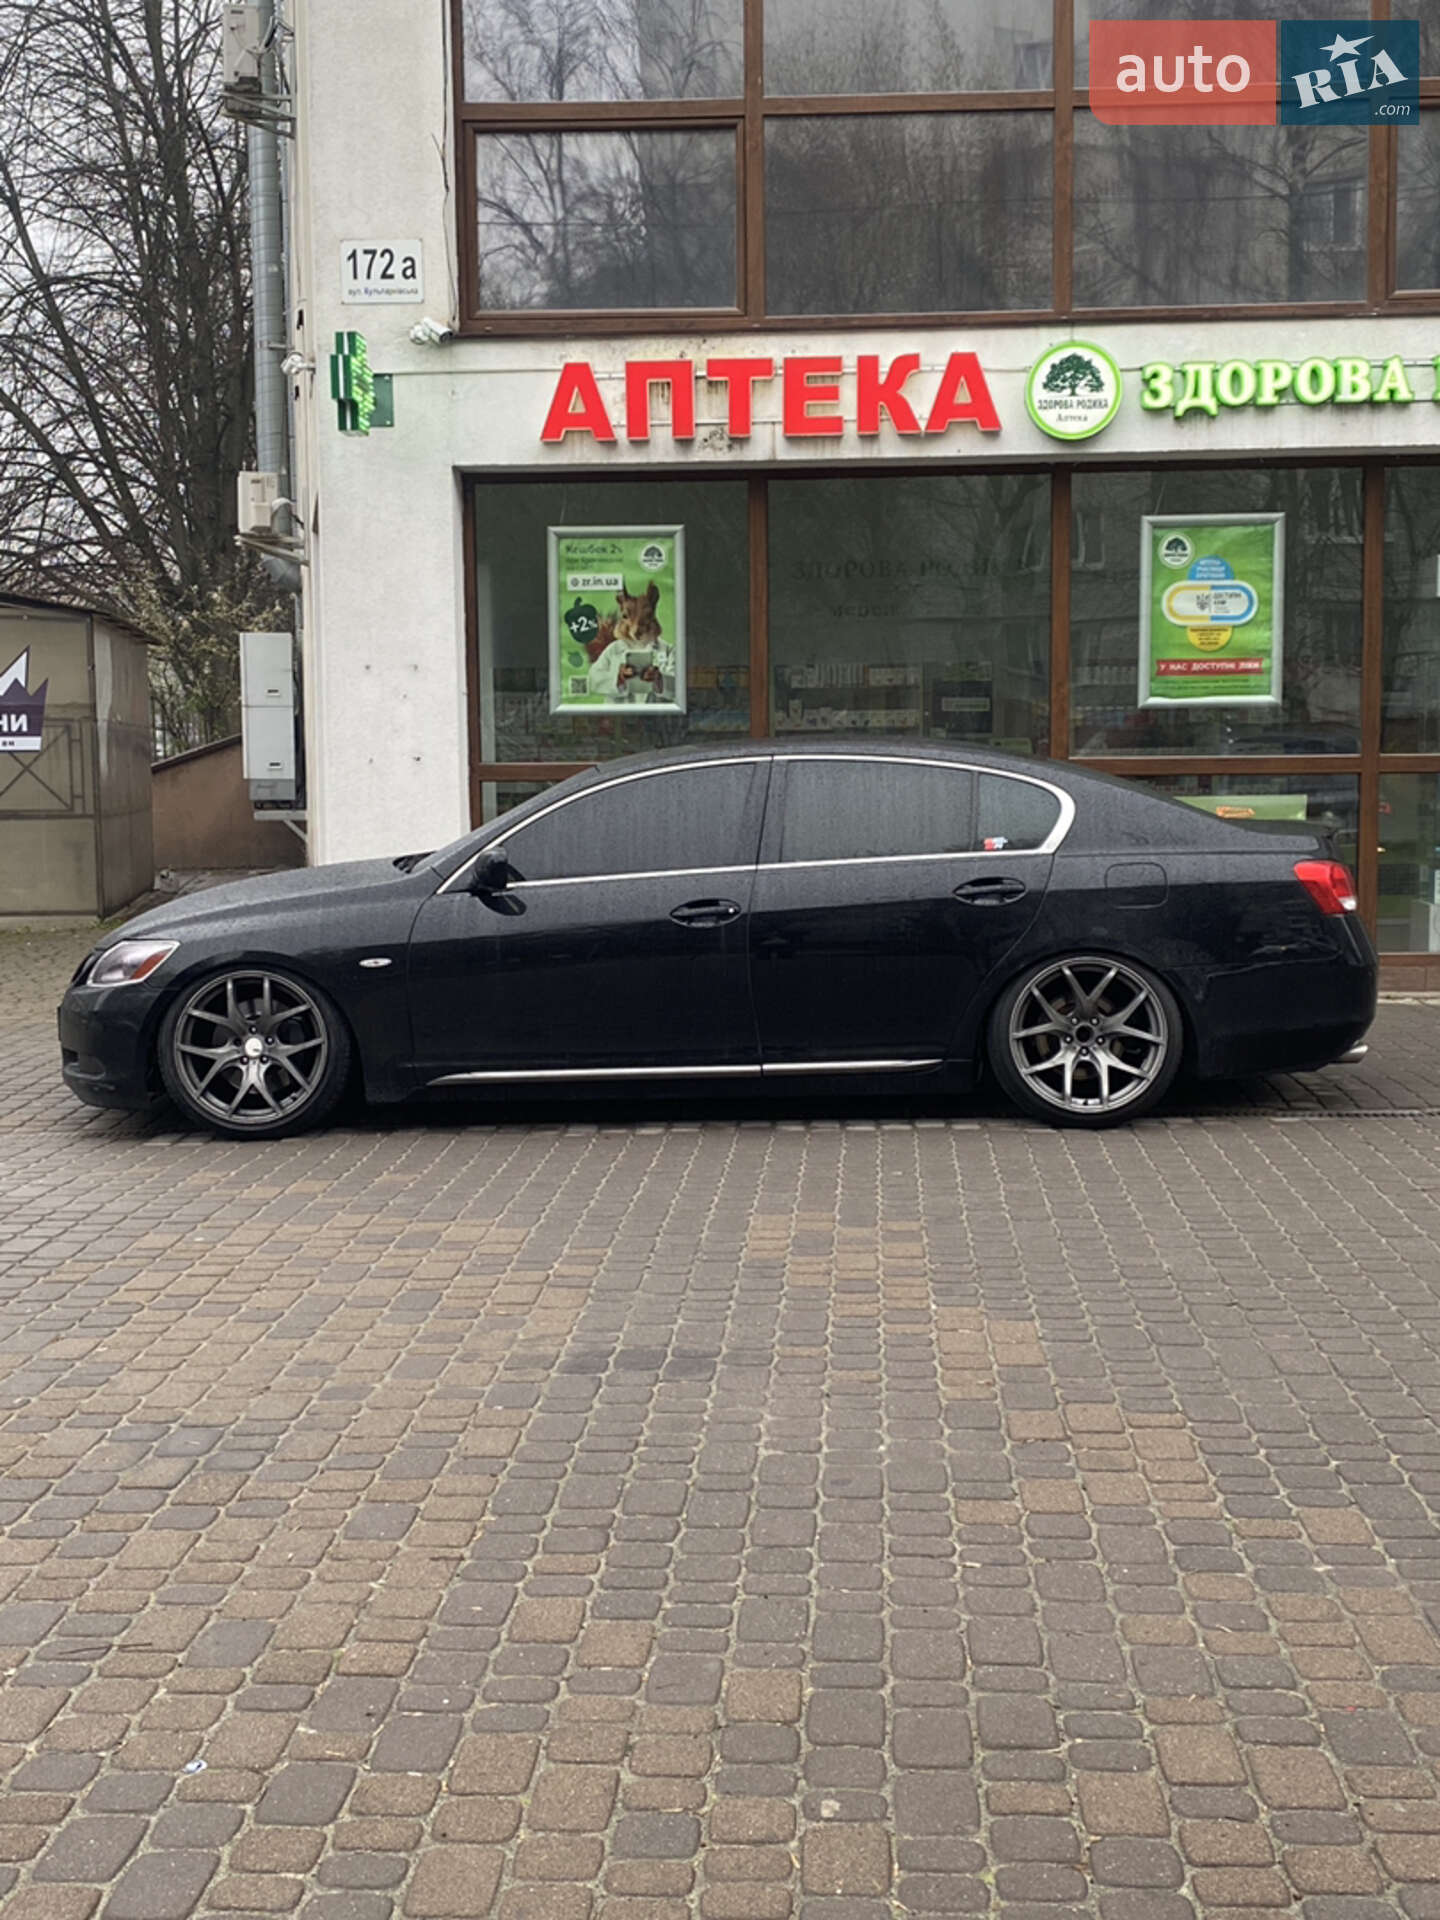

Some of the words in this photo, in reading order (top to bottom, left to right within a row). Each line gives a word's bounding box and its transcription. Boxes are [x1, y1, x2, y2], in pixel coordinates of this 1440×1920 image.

[539, 351, 1003, 443] АПТЕКА
[1037, 399, 1074, 410] ЗДОРОВА
[1076, 398, 1109, 409] РОДИНА
[1141, 354, 1413, 419] ЗДОРОВА
[1056, 413, 1089, 422] Аптека
